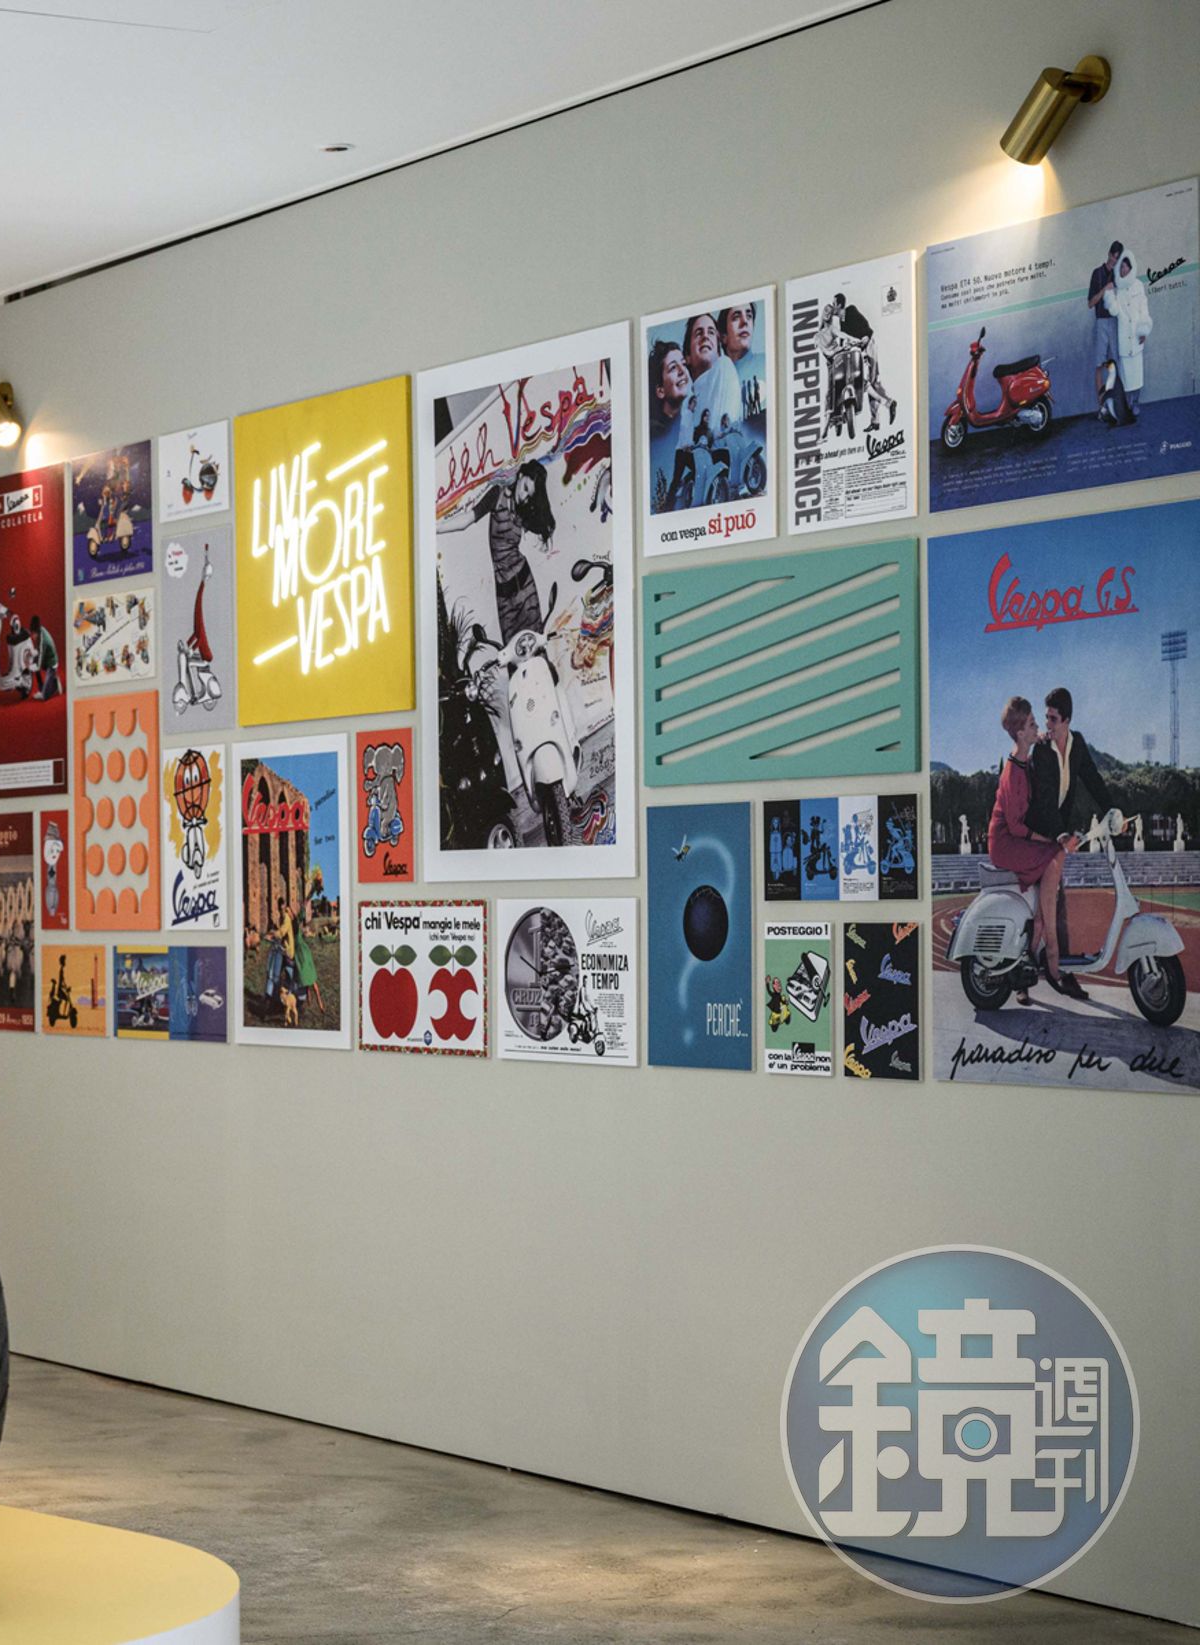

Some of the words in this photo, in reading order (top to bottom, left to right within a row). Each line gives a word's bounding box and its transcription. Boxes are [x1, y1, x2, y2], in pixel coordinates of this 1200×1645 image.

[1146, 256, 1186, 286] Vespa
[792, 298, 821, 526] INDEPENDENCE
[867, 429, 905, 461] Vespa
[252, 442, 321, 558] LIVE
[272, 465, 389, 607] MORE
[661, 530, 678, 542] con
[679, 526, 706, 541] vespa
[984, 552, 1087, 634] Vespa
[298, 554, 390, 675] VESPA
[242, 773, 309, 839] Vespa
[383, 852, 408, 876] Vespa
[171, 869, 219, 926] Vespa
[364, 911, 382, 930] chi
[422, 917, 452, 933] mangia
[453, 917, 460, 930] le
[462, 918, 480, 930] mele
[585, 909, 623, 946] Vespa
[767, 926, 823, 936] POSTEGGIO
[581, 953, 629, 971] ECONOMIZA
[591, 973, 619, 990] TEMPO
[860, 1011, 917, 1055] Vespa
[791, 1063, 830, 1071] problema
[950, 1037, 1057, 1080] paradiso
[1068, 1043, 1112, 1079] per
[1130, 1046, 1184, 1078] due
